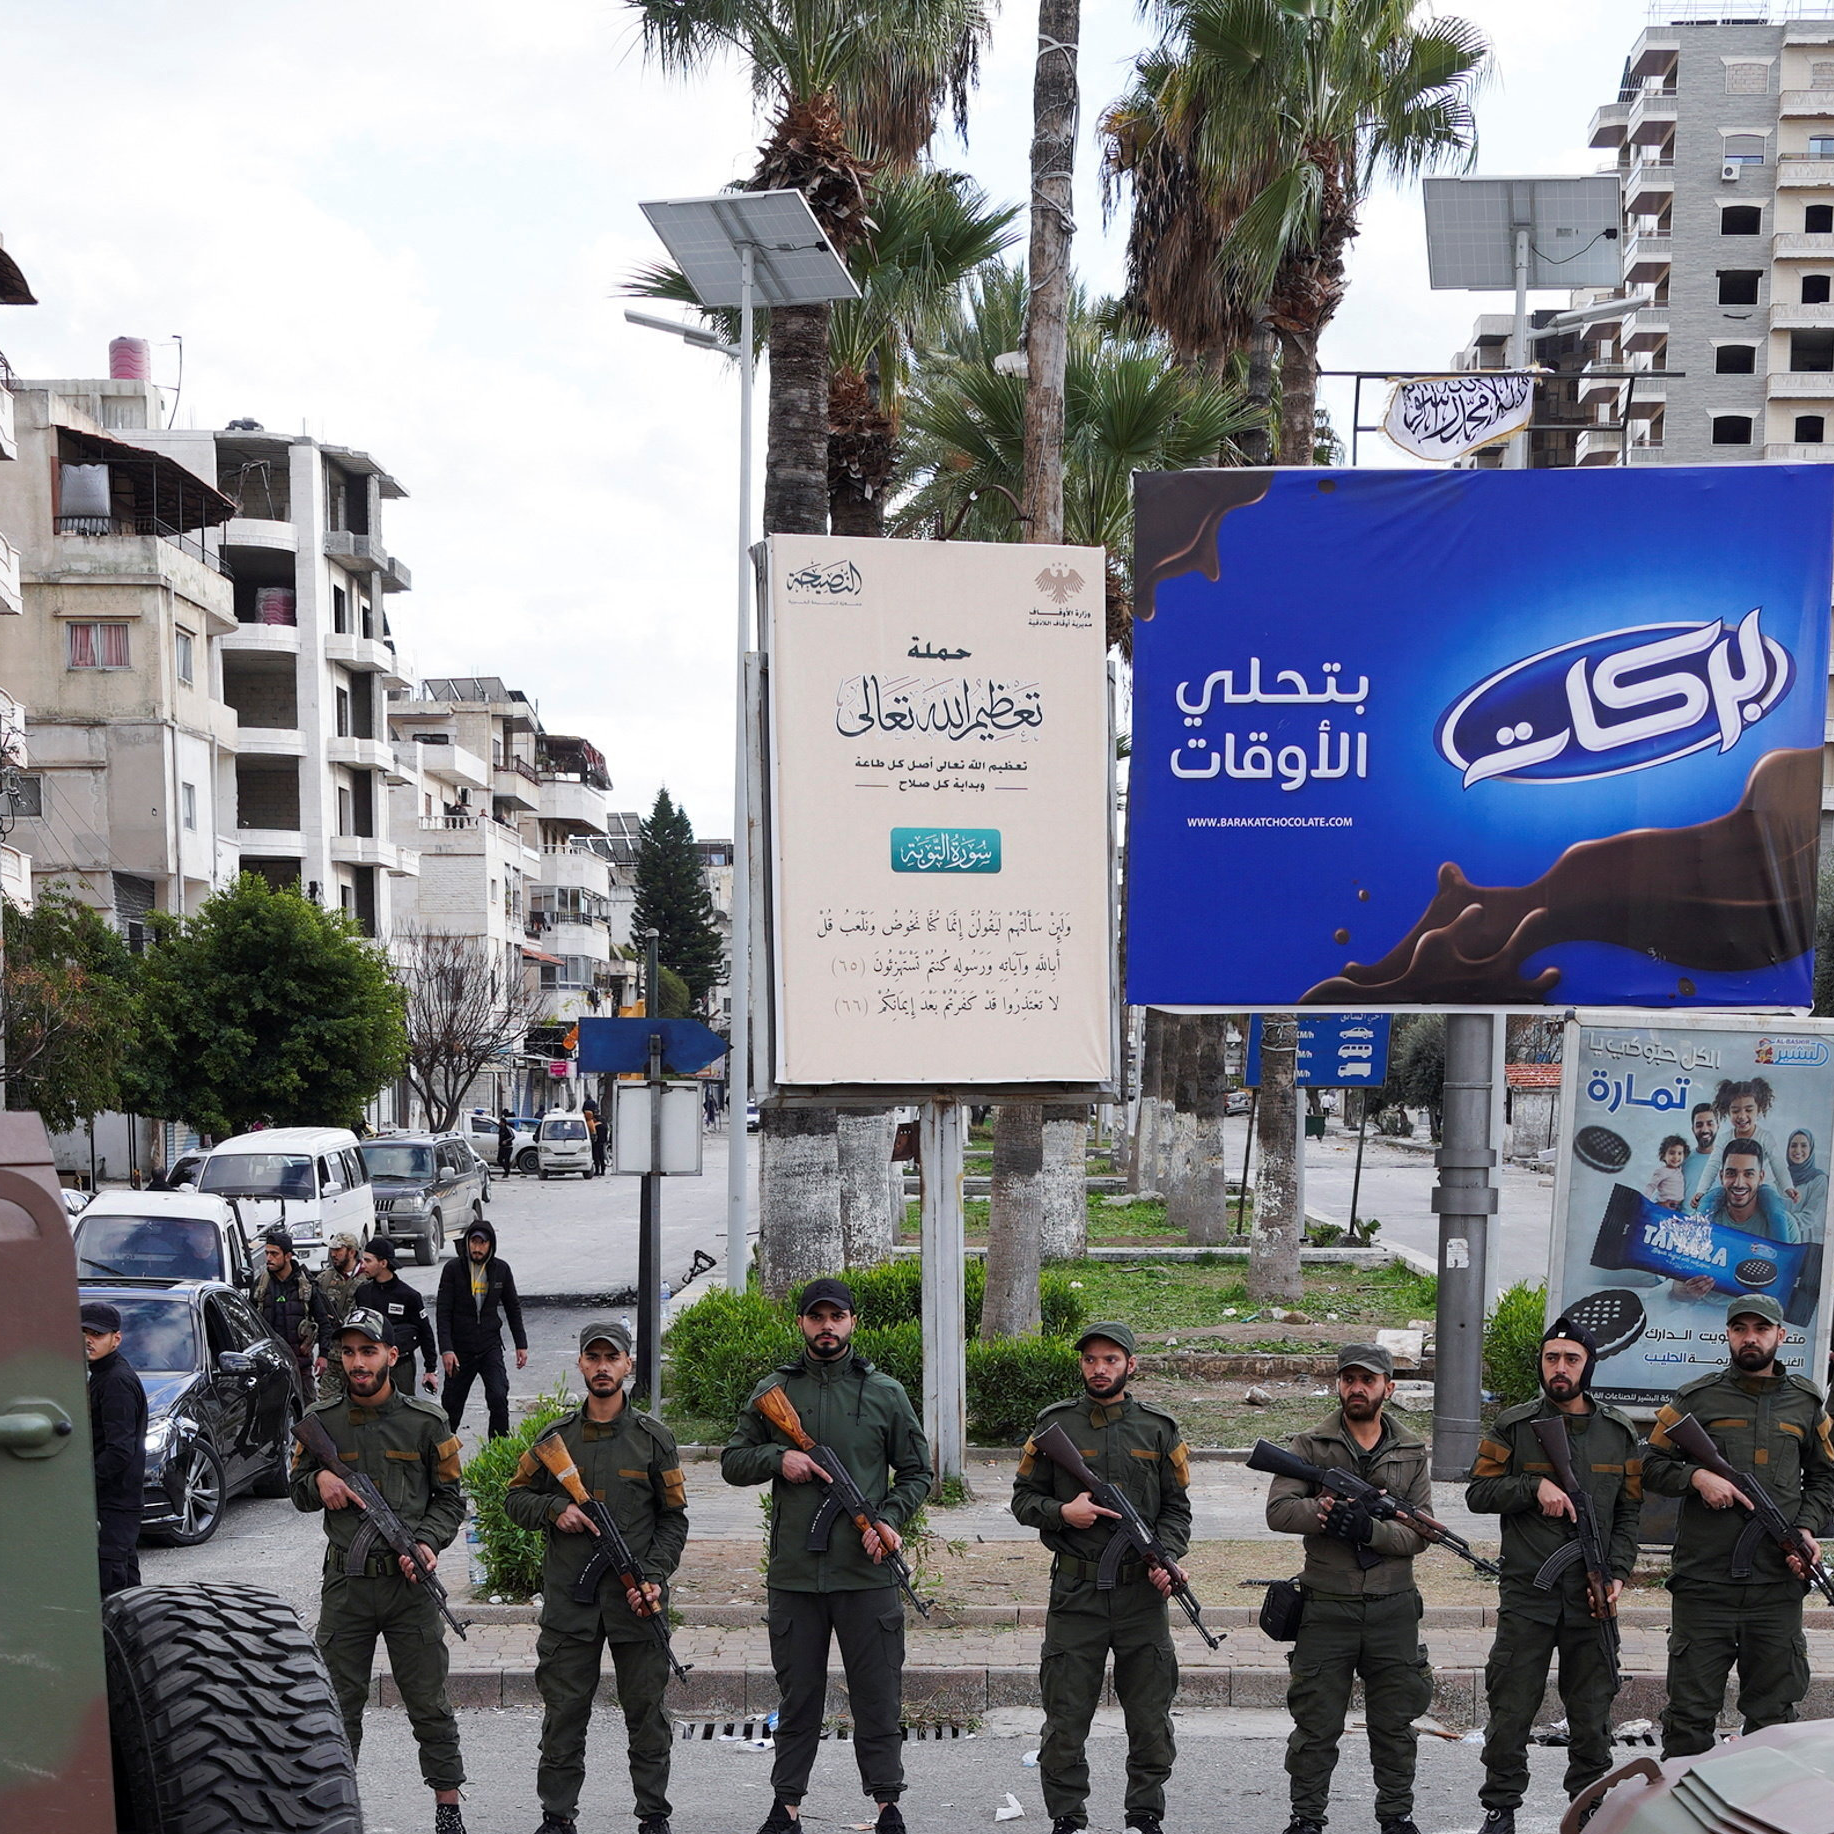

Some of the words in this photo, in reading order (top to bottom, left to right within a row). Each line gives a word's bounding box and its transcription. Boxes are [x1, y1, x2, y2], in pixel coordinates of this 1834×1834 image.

[1075, 609, 1091, 618] وزارة
[1053, 619, 1070, 628] أوقاف
[1071, 620, 1092, 629] مديرية
[907, 636, 972, 661] حملة
[1175, 657, 1369, 727] بتحلي
[1463, 607, 1771, 790] بركات
[1170, 719, 1367, 791] الأوقات
[855, 756, 885, 769] طاعة
[887, 759, 904, 771] كل
[907, 756, 933, 771] أصل
[936, 760, 965, 773] تعالى
[968, 758, 985, 771] الله
[988, 760, 1028, 774] تعظيم
[898, 778, 930, 792] صلاح
[933, 779, 949, 791] كل
[953, 778, 985, 792] وبداية
[1187, 816, 1353, 828] WWW.BARAKATCHOCOLATE.COM
[1048, 995, 1059, 1012] لا
[1588, 1031, 1605, 1057] يا
[1680, 1045, 1721, 1071] الكل
[1587, 1069, 1692, 1114] تمارة
[1645, 1328, 1693, 1342] الدارك
[1783, 1333, 1806, 1345] متع
[1644, 1351, 1686, 1366] الحليب
[1688, 1353, 1732, 1368] ريمة
[1660, 1394, 1673, 1403] ركة
